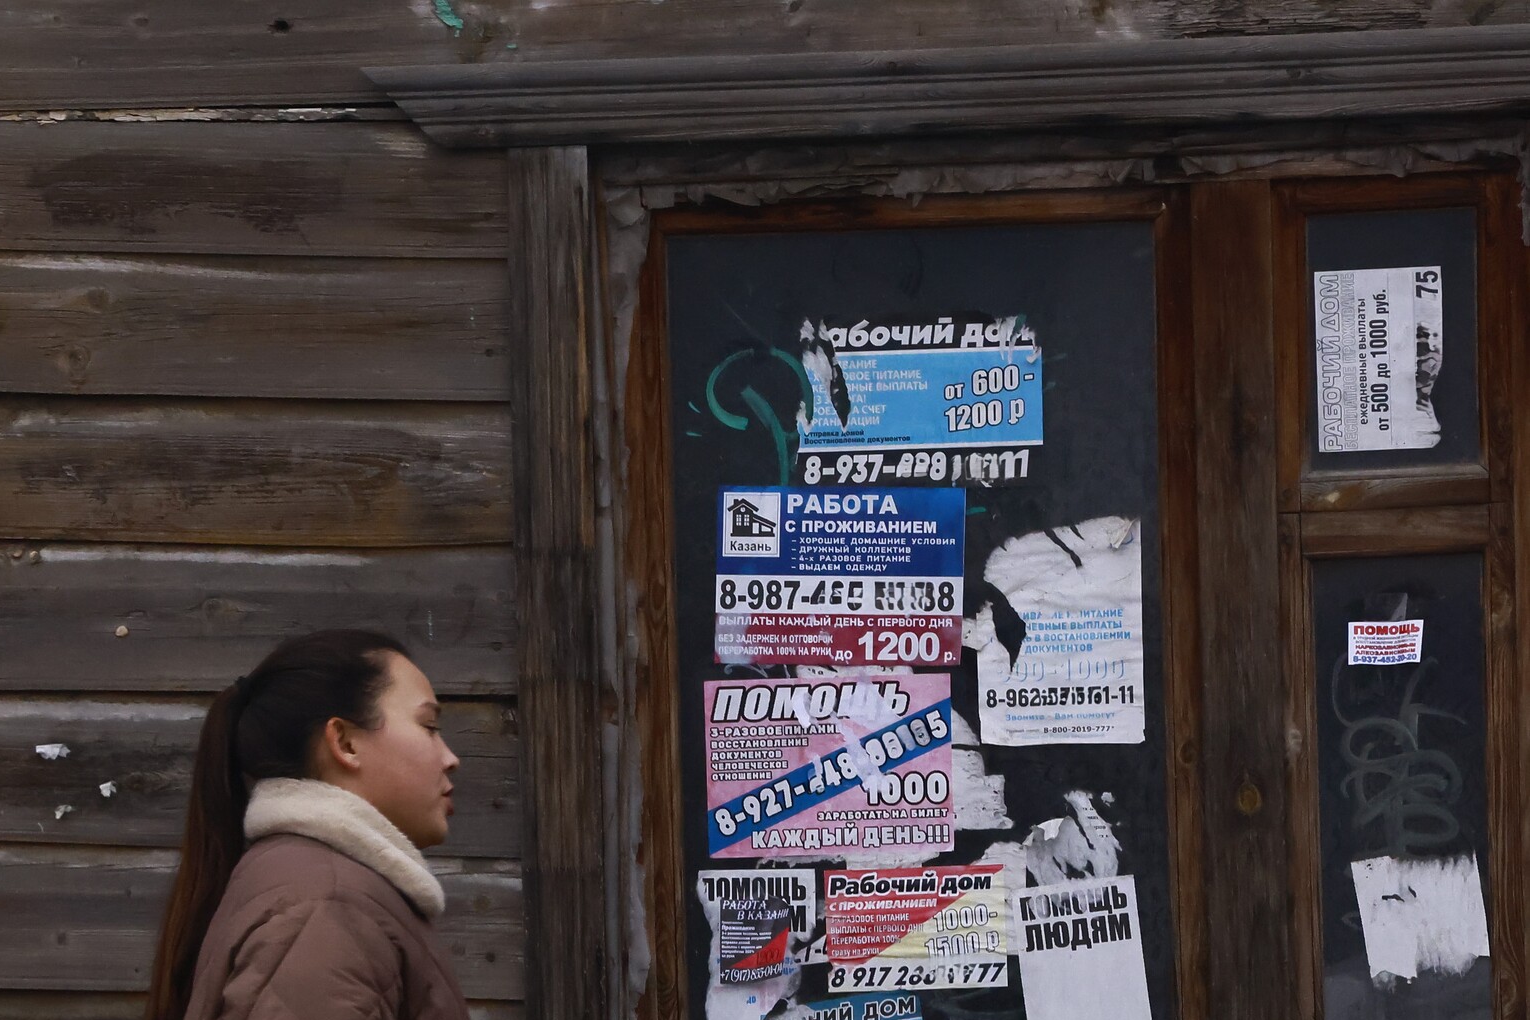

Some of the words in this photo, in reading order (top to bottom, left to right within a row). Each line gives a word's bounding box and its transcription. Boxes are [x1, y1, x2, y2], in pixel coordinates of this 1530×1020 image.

[1319, 274, 1339, 332] ДОМ
[1373, 289, 1389, 314] руб.
[1341, 273, 1357, 363] ПРОЖИВАНИЕ
[1358, 298, 1367, 349] выплаты
[1369, 319, 1388, 358] 1000
[873, 370, 921, 380] ПИТАНИЕ
[1378, 363, 1390, 378] до
[876, 381, 927, 390] ВЫПЛАТЫ
[944, 383, 964, 400] от
[971, 364, 1019, 397] 600
[1317, 336, 1343, 451] РАБОЧИЙ
[1359, 353, 1370, 425] ежедневные
[1371, 383, 1389, 412] 500
[862, 405, 886, 414] СЧЕТ
[945, 400, 1003, 432] 1200
[1008, 397, 1025, 425] р
[1343, 367, 1358, 450] БЕСПЛАТНОЕ
[1379, 418, 1389, 431] от
[787, 495, 898, 514] РАБОТА
[785, 520, 796, 532] С
[802, 521, 936, 533] ПРОЖИВАНИЕМ
[730, 541, 771, 552] Казань
[799, 546, 849, 554] ДРУЖНЫЙ
[720, 616, 775, 626] ВЫПЛАТЫ
[779, 615, 831, 627] КАЖДЫЙ
[834, 617, 864, 627] ДЕНЬ
[867, 618, 874, 626] С
[878, 618, 925, 626] ПЕРВОГО
[928, 618, 953, 628] ДНЯ
[1070, 621, 1122, 630] ВЫПЛАТЫ
[1354, 624, 1420, 635] ПОМОЩЬ
[718, 634, 734, 643] БЕЗ
[736, 634, 779, 644] ЗАДЕРЖЕК
[782, 635, 787, 643] И
[789, 634, 833, 643] ОТГОВОРОК
[1044, 632, 1130, 642] ВОСТАНОВЛЕНИИ
[718, 647, 773, 655] ПЕРЕРАБОТКА
[776, 647, 796, 655] 100%
[798, 647, 809, 655] НА
[811, 647, 832, 656] РУКИ
[858, 632, 940, 661] 1200
[944, 652, 956, 662] р.
[1025, 644, 1092, 654] ДОКУМЕНТОВ
[711, 727, 781, 737] 3-РАЗОВОЕ
[711, 738, 809, 749] ВОССТАНОВЛЕНИЕ
[711, 750, 782, 761] ДОКУМЕНТОВ
[711, 760, 788, 771] ЧЕЛОВЕЧЕСКОЕ
[711, 771, 772, 781] ОТНОШЕНИЕ
[862, 771, 948, 805] 1000
[818, 810, 890, 821] ЗАРАБОТАТЬ
[892, 810, 908, 819] НА
[911, 808, 949, 819] БИЛЕТ
[752, 823, 858, 849] КАЖДЫЙ
[862, 825, 950, 848] ДЕНЬ!!!
[829, 872, 938, 897] Рабочий
[939, 874, 992, 897] дом
[723, 900, 766, 909] РАБОТА
[838, 898, 937, 910] ПРОЖИВАНИЕМ
[1020, 886, 1127, 921] ПОМОЩЬ
[737, 911, 745, 920] В
[748, 908, 789, 920] КАЗАНИ
[842, 915, 874, 923] РАЗОВОЕ
[831, 926, 866, 934] ВЫПЛАТЫ
[1026, 913, 1131, 952] ЛЮДЯМ
[831, 936, 880, 945] ПЕРЕРАБОТКА
[883, 935, 901, 943] 100%
[925, 934, 980, 959] 1500
[985, 931, 1000, 952] р
[831, 967, 846, 987] 8
[853, 967, 893, 986] 917
